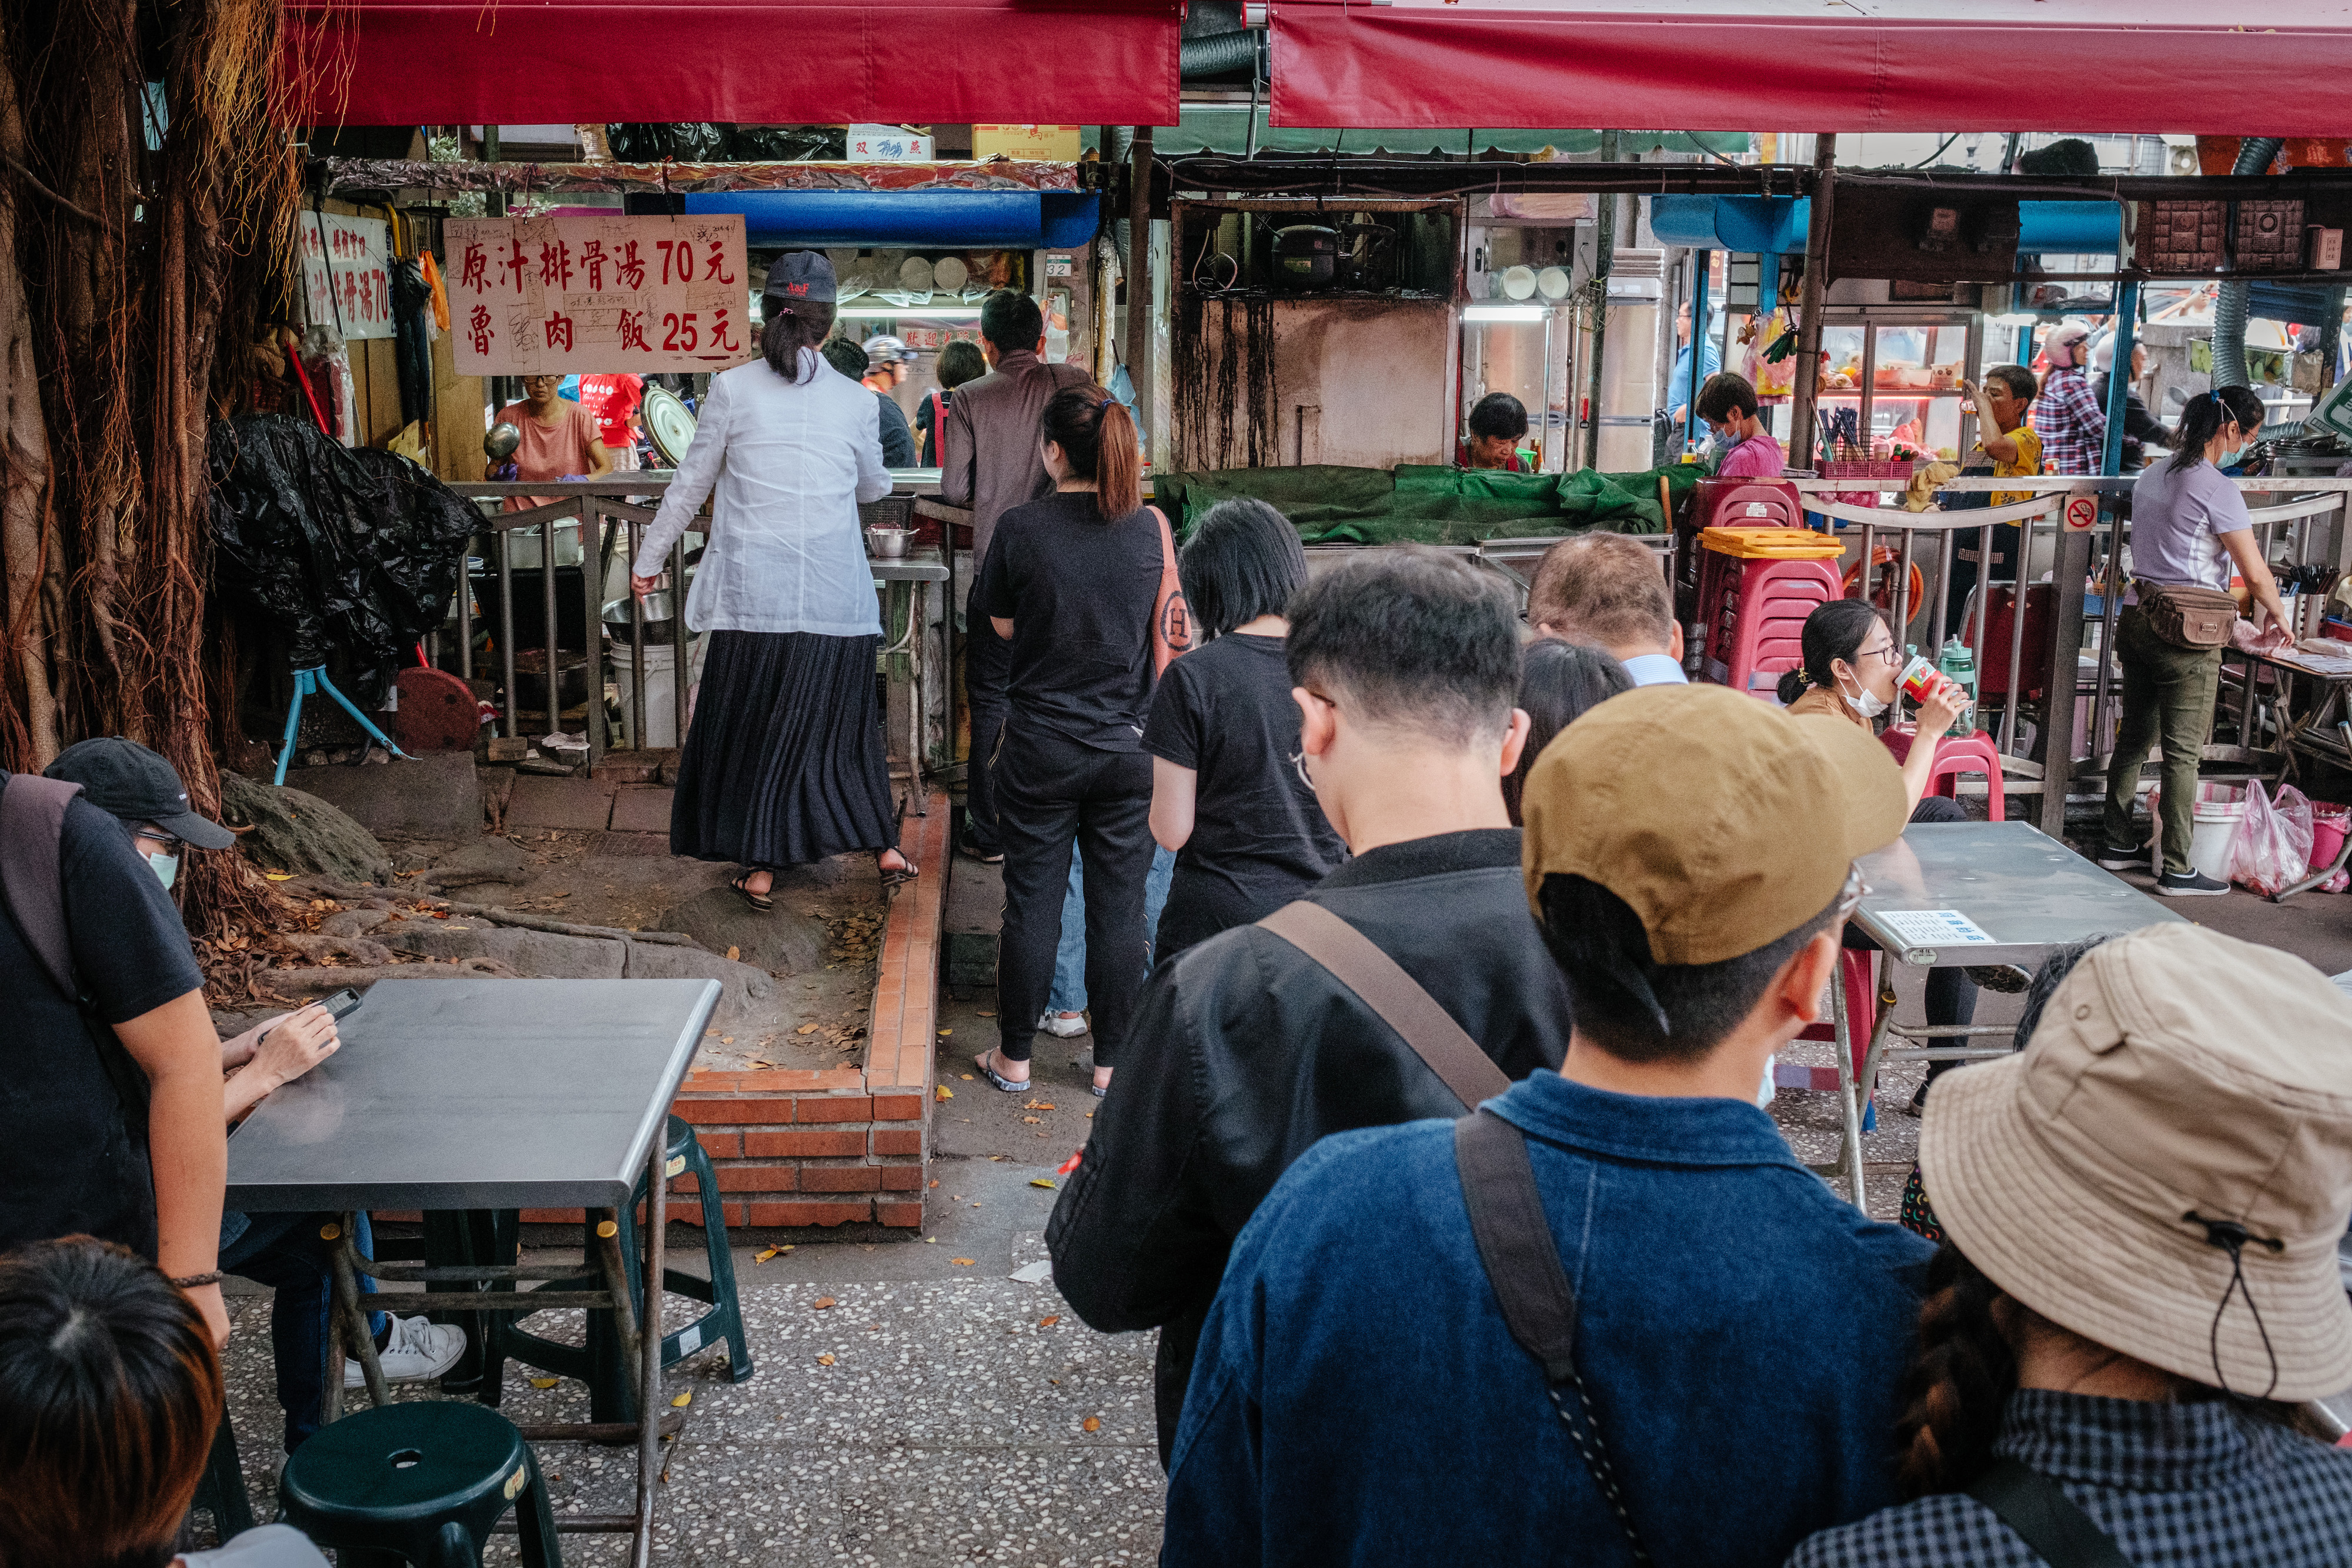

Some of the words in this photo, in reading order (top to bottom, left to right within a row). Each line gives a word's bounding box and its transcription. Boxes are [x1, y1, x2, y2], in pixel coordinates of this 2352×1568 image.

[856, 142, 868, 154] 双
[909, 140, 921, 154] 燕
[301, 225, 323, 259] 大稻
[333, 229, 366, 260] 媽祖宮口
[787, 282, 809, 292] A&F
